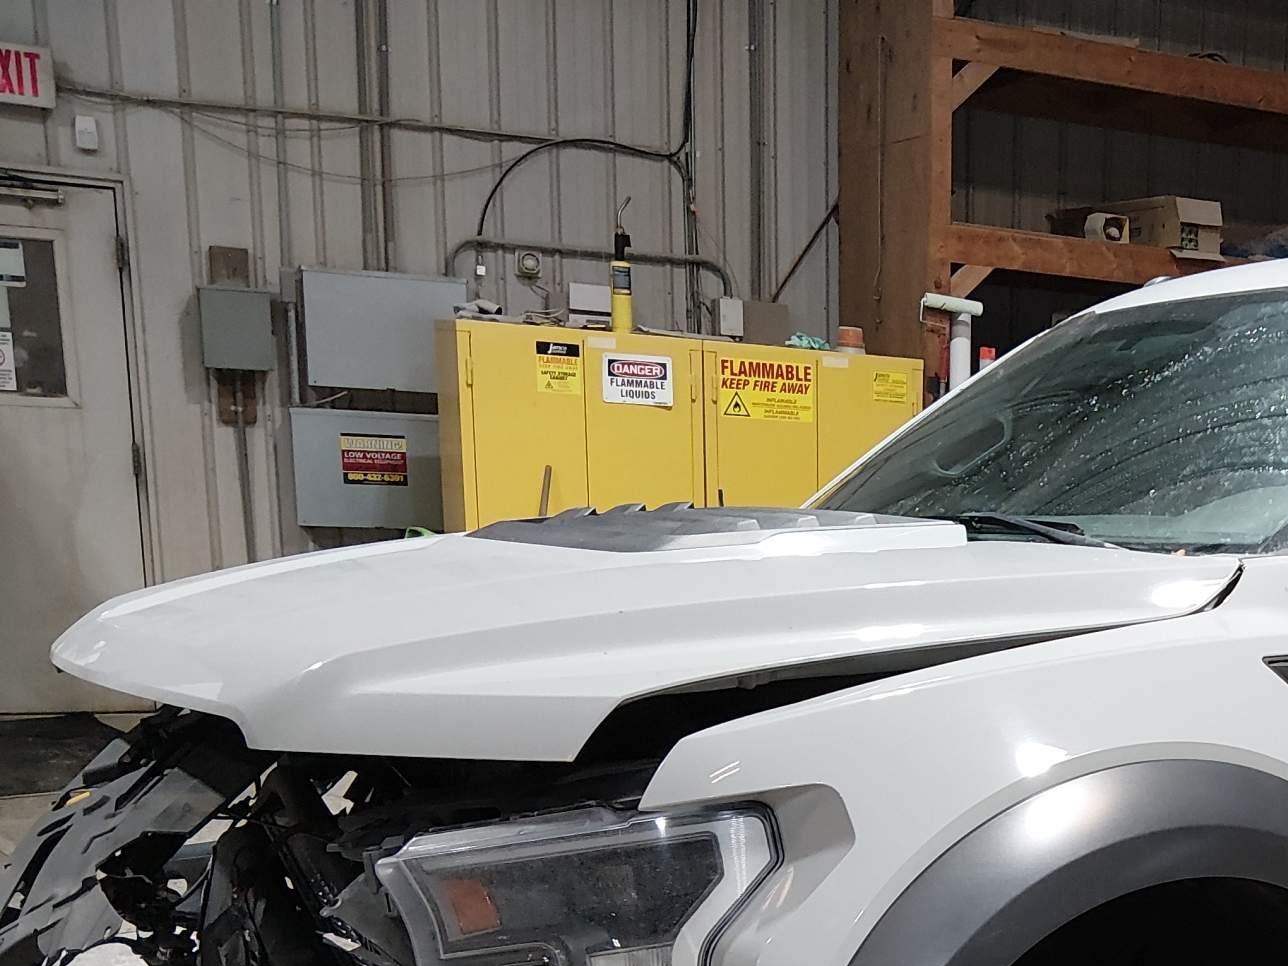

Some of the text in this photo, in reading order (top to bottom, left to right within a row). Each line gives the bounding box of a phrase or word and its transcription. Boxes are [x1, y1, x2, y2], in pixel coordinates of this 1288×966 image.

[0, 48, 40, 97] XIT
[614, 363, 660, 376] DANGER
[720, 359, 812, 382] FLAMMABLE
[610, 378, 666, 390] FLAMMABLE
[721, 377, 811, 395] KEEP FIRE AWAY
[620, 389, 656, 400] LIQUIDS
[344, 451, 402, 460] LOW VOLTAGE
